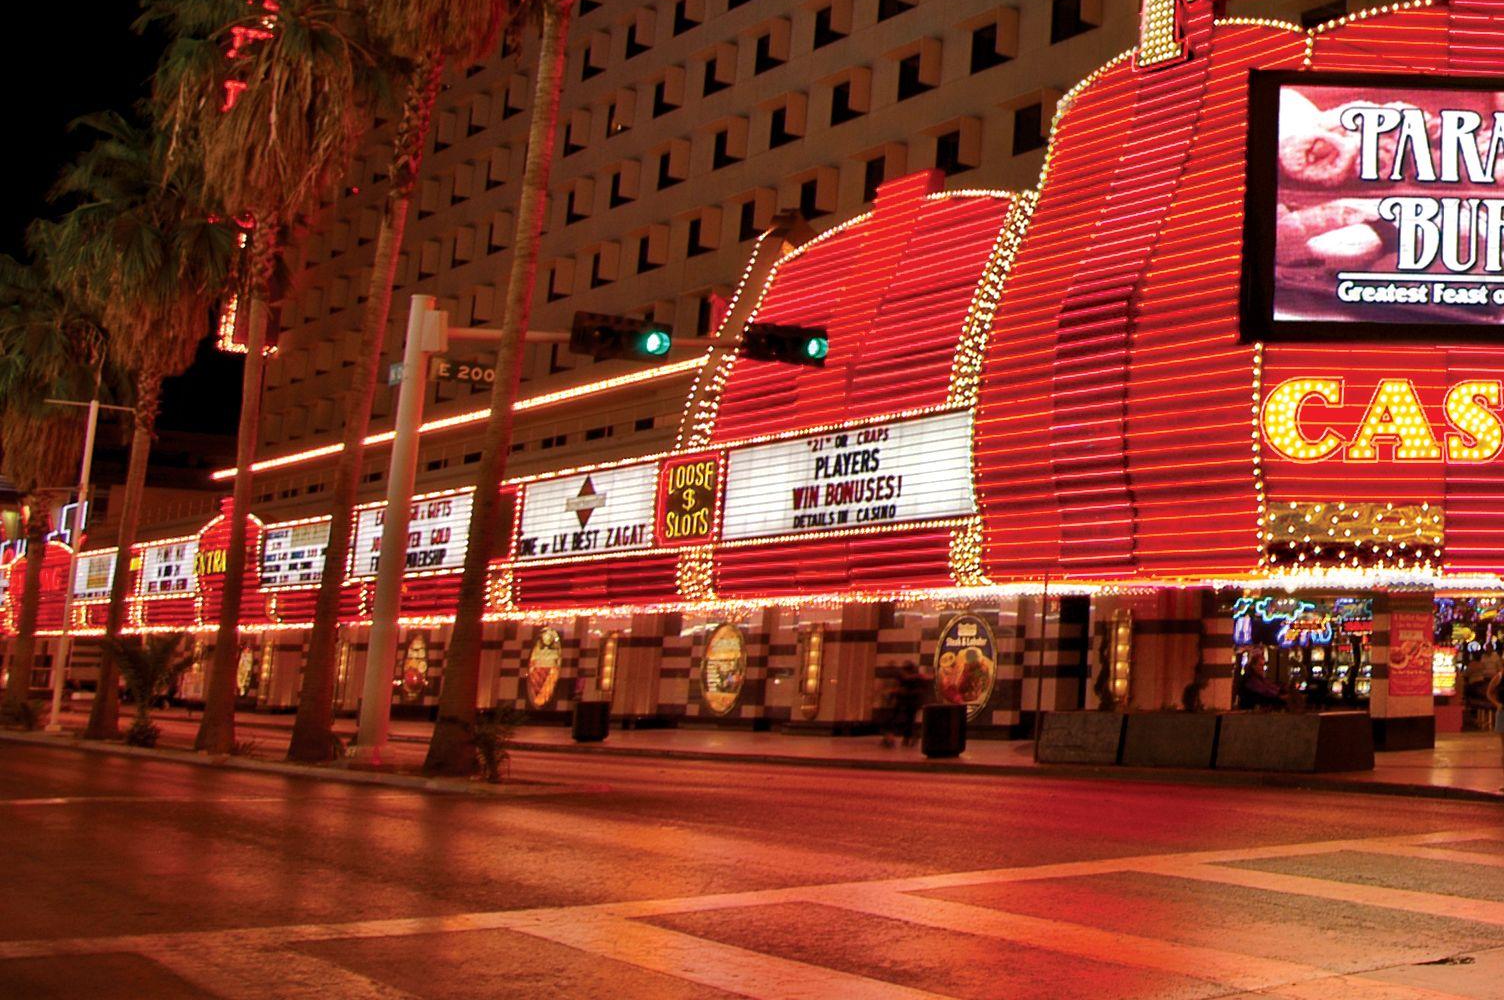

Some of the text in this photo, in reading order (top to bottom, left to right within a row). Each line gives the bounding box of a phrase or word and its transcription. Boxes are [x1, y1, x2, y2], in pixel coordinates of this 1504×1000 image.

[1337, 281, 1428, 303] Greatest
[1433, 282, 1489, 305] Feast
[457, 366, 496, 382] 200
[857, 428, 889, 445] CRAPS
[668, 462, 714, 494] LOOSE
[815, 448, 880, 480] PLAYERS
[792, 475, 902, 510] WIN BONUSES!
[665, 507, 709, 538] SLOTS
[793, 504, 896, 529] DETAILS IN CASINO
[572, 529, 600, 551] BEST
[606, 523, 645, 547] ZAGAT
